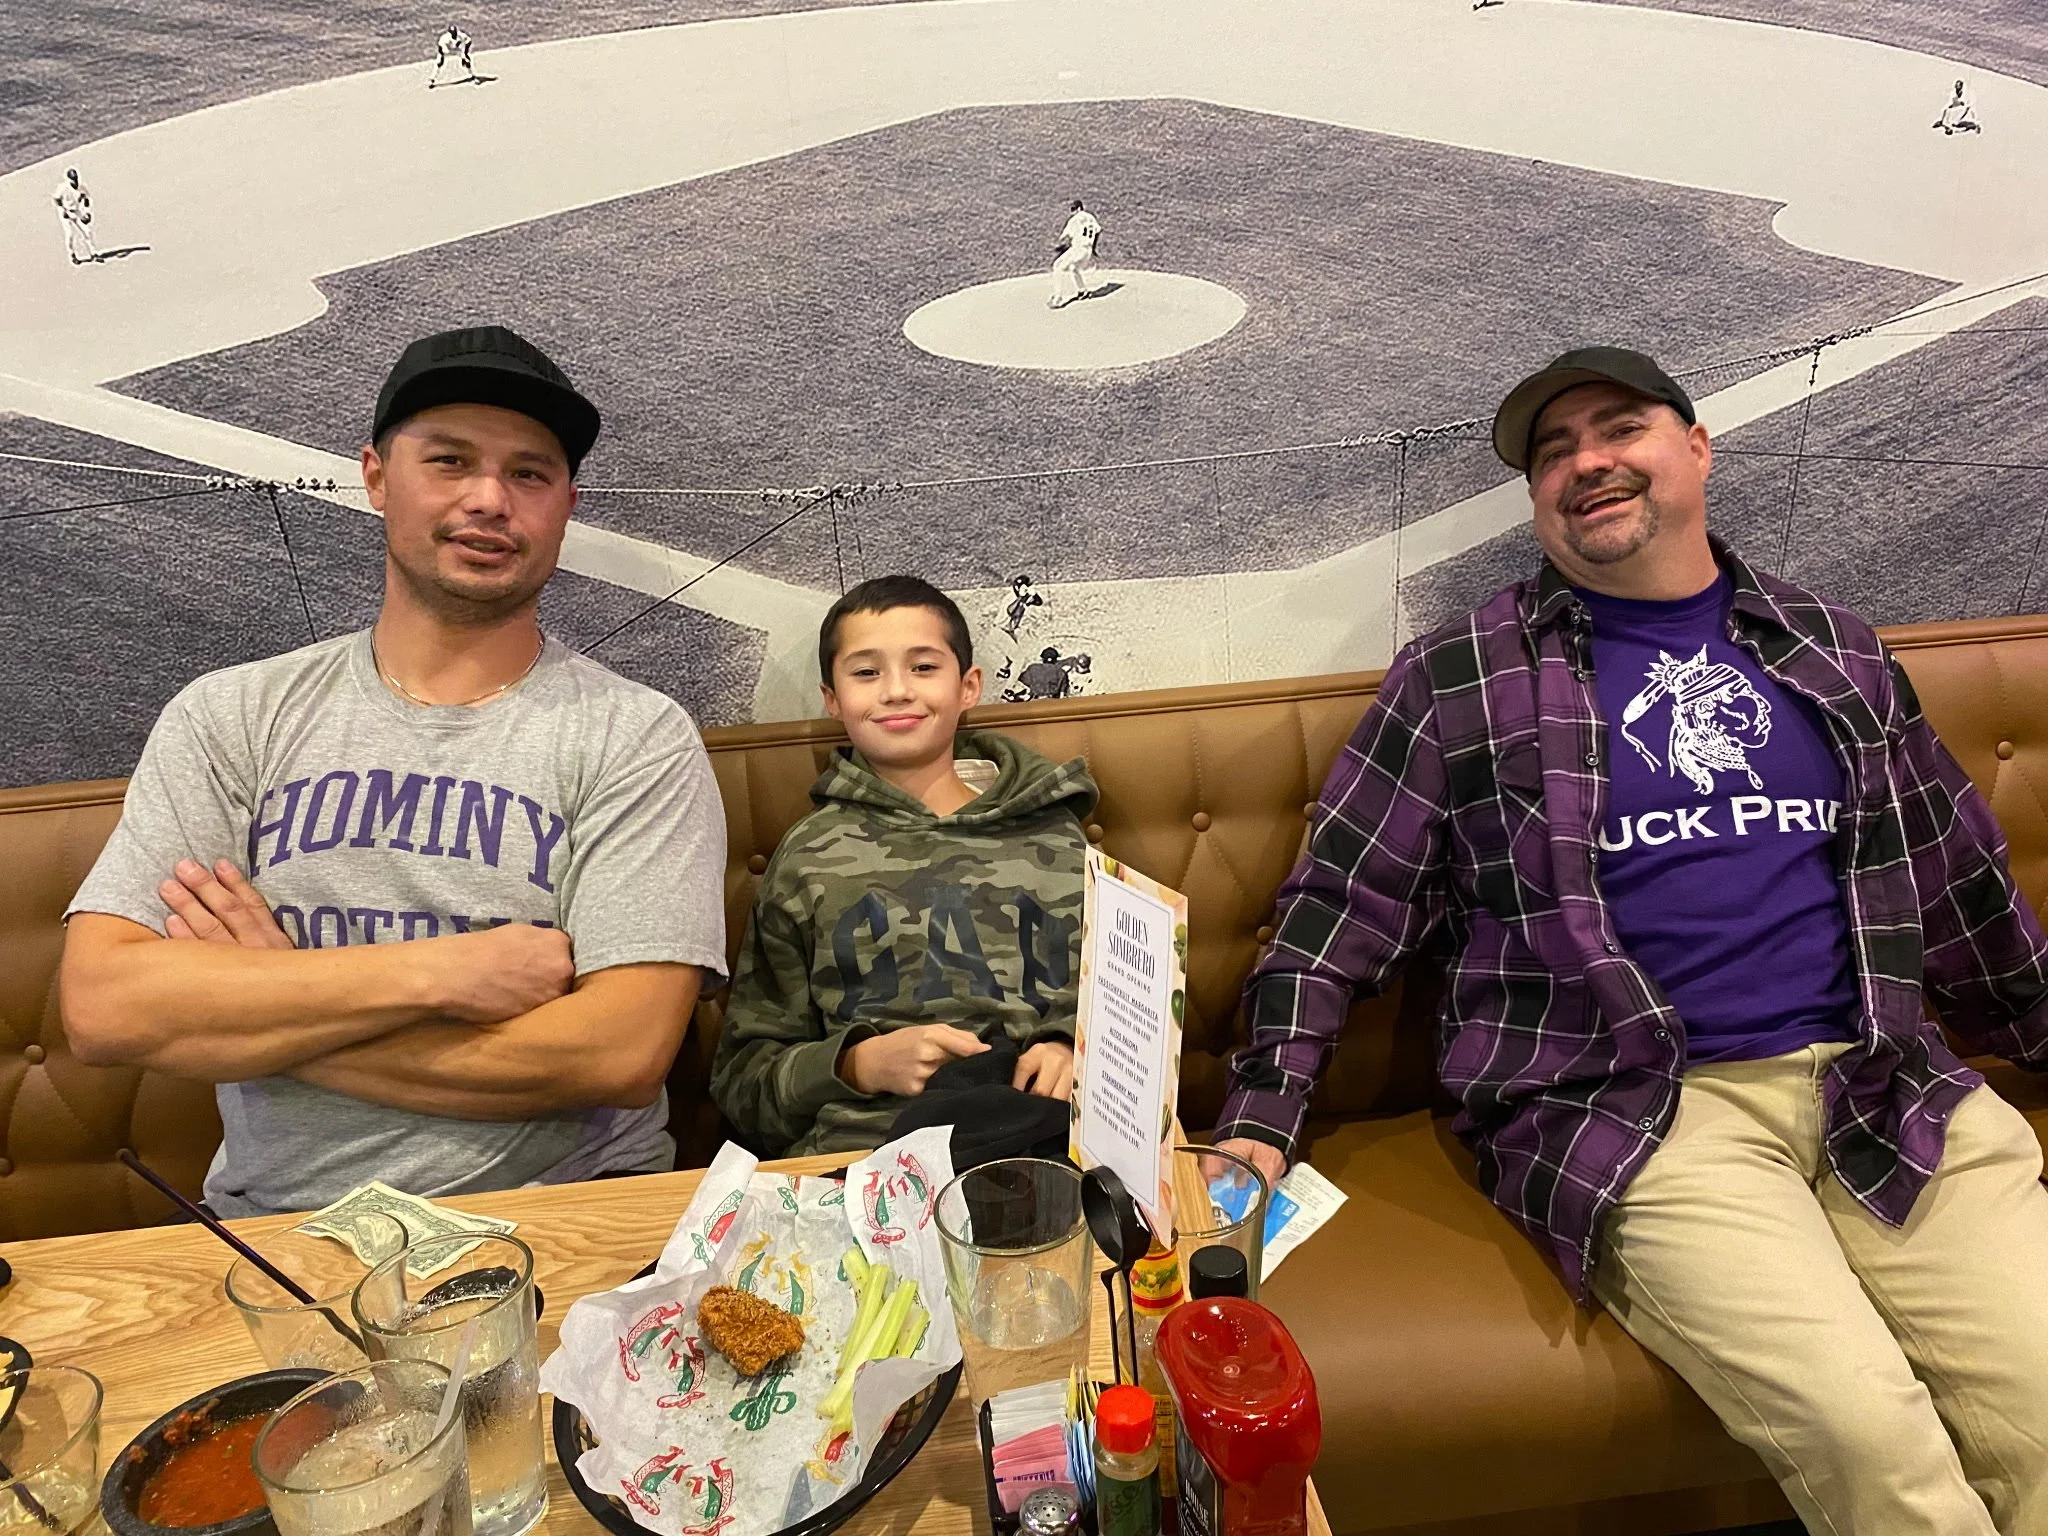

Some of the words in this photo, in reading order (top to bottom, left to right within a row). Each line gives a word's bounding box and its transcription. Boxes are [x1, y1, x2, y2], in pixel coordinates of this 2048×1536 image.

[249, 769, 566, 894] HOMINY
[1599, 805, 1720, 852] UCK
[1729, 794, 1843, 837] PRI
[1116, 907, 1149, 947] GOLDEN
[1107, 929, 1156, 980] SOMBRERO
[1107, 960, 1124, 977] GRAND
[1126, 972, 1151, 995] OPENING
[1131, 996, 1158, 1022] MARGARITA
[1122, 1034, 1138, 1053] PALOMA
